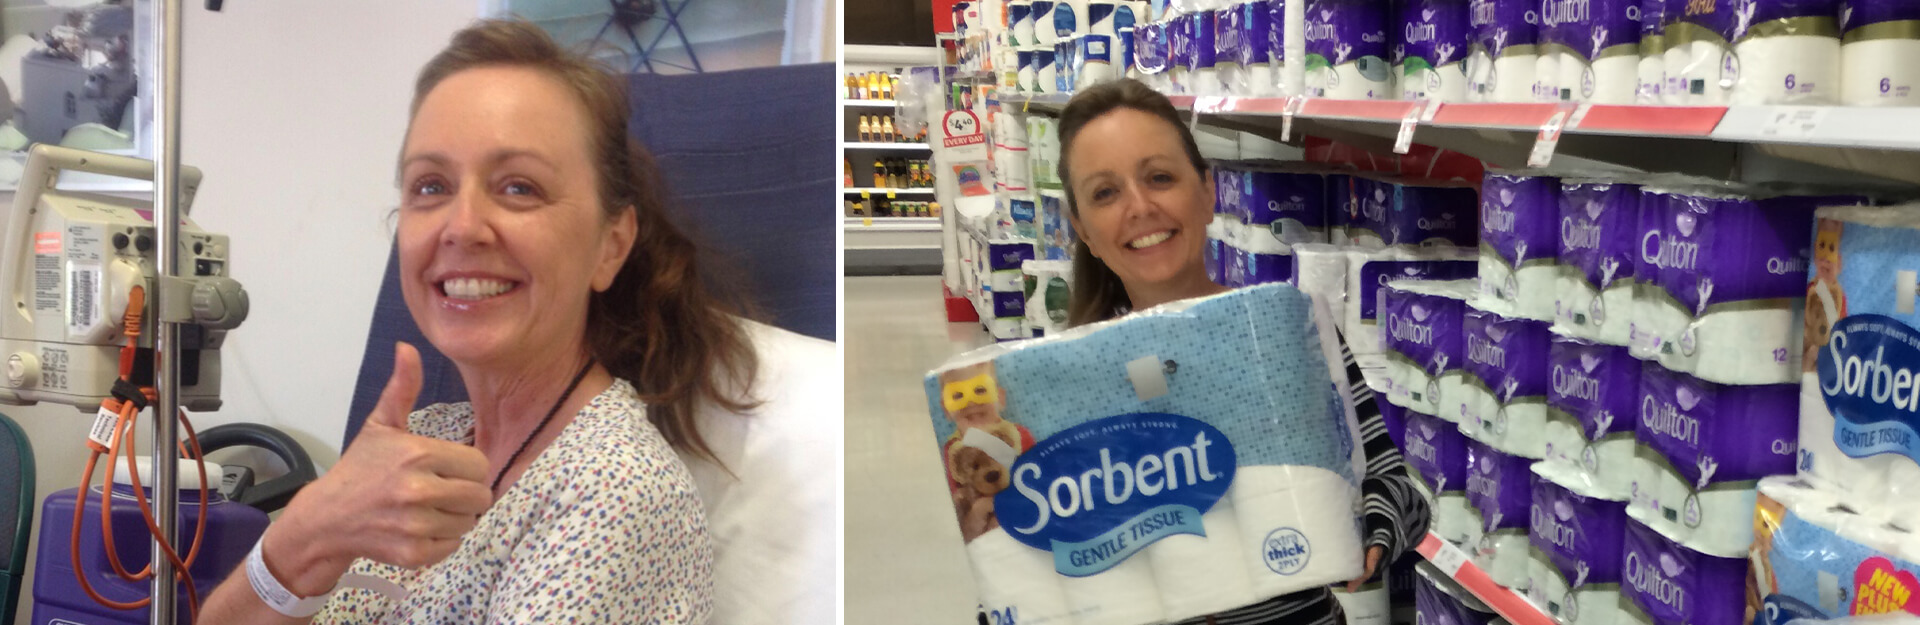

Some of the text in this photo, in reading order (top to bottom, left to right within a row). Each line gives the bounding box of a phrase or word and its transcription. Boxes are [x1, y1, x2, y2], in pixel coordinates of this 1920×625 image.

[1405, 21, 1436, 44] Quilton
[1785, 73, 1796, 90] 6
[1879, 77, 1891, 93] 6
[1482, 201, 1515, 233] Quilton
[1562, 216, 1602, 251] Quilton
[1390, 303, 1433, 345] Quilton
[1772, 348, 1788, 363] 12
[1553, 364, 1600, 402] Quilton
[1642, 394, 1699, 446] Quilton
[1841, 427, 1912, 450] GENTLE TISSUE
[1013, 430, 1218, 535] Sorbent
[1069, 510, 1186, 568] GENTLE TISSUE
[1267, 542, 1306, 562] thick
[1626, 551, 1684, 612] Quilton
[1869, 567, 1911, 607] NEW
